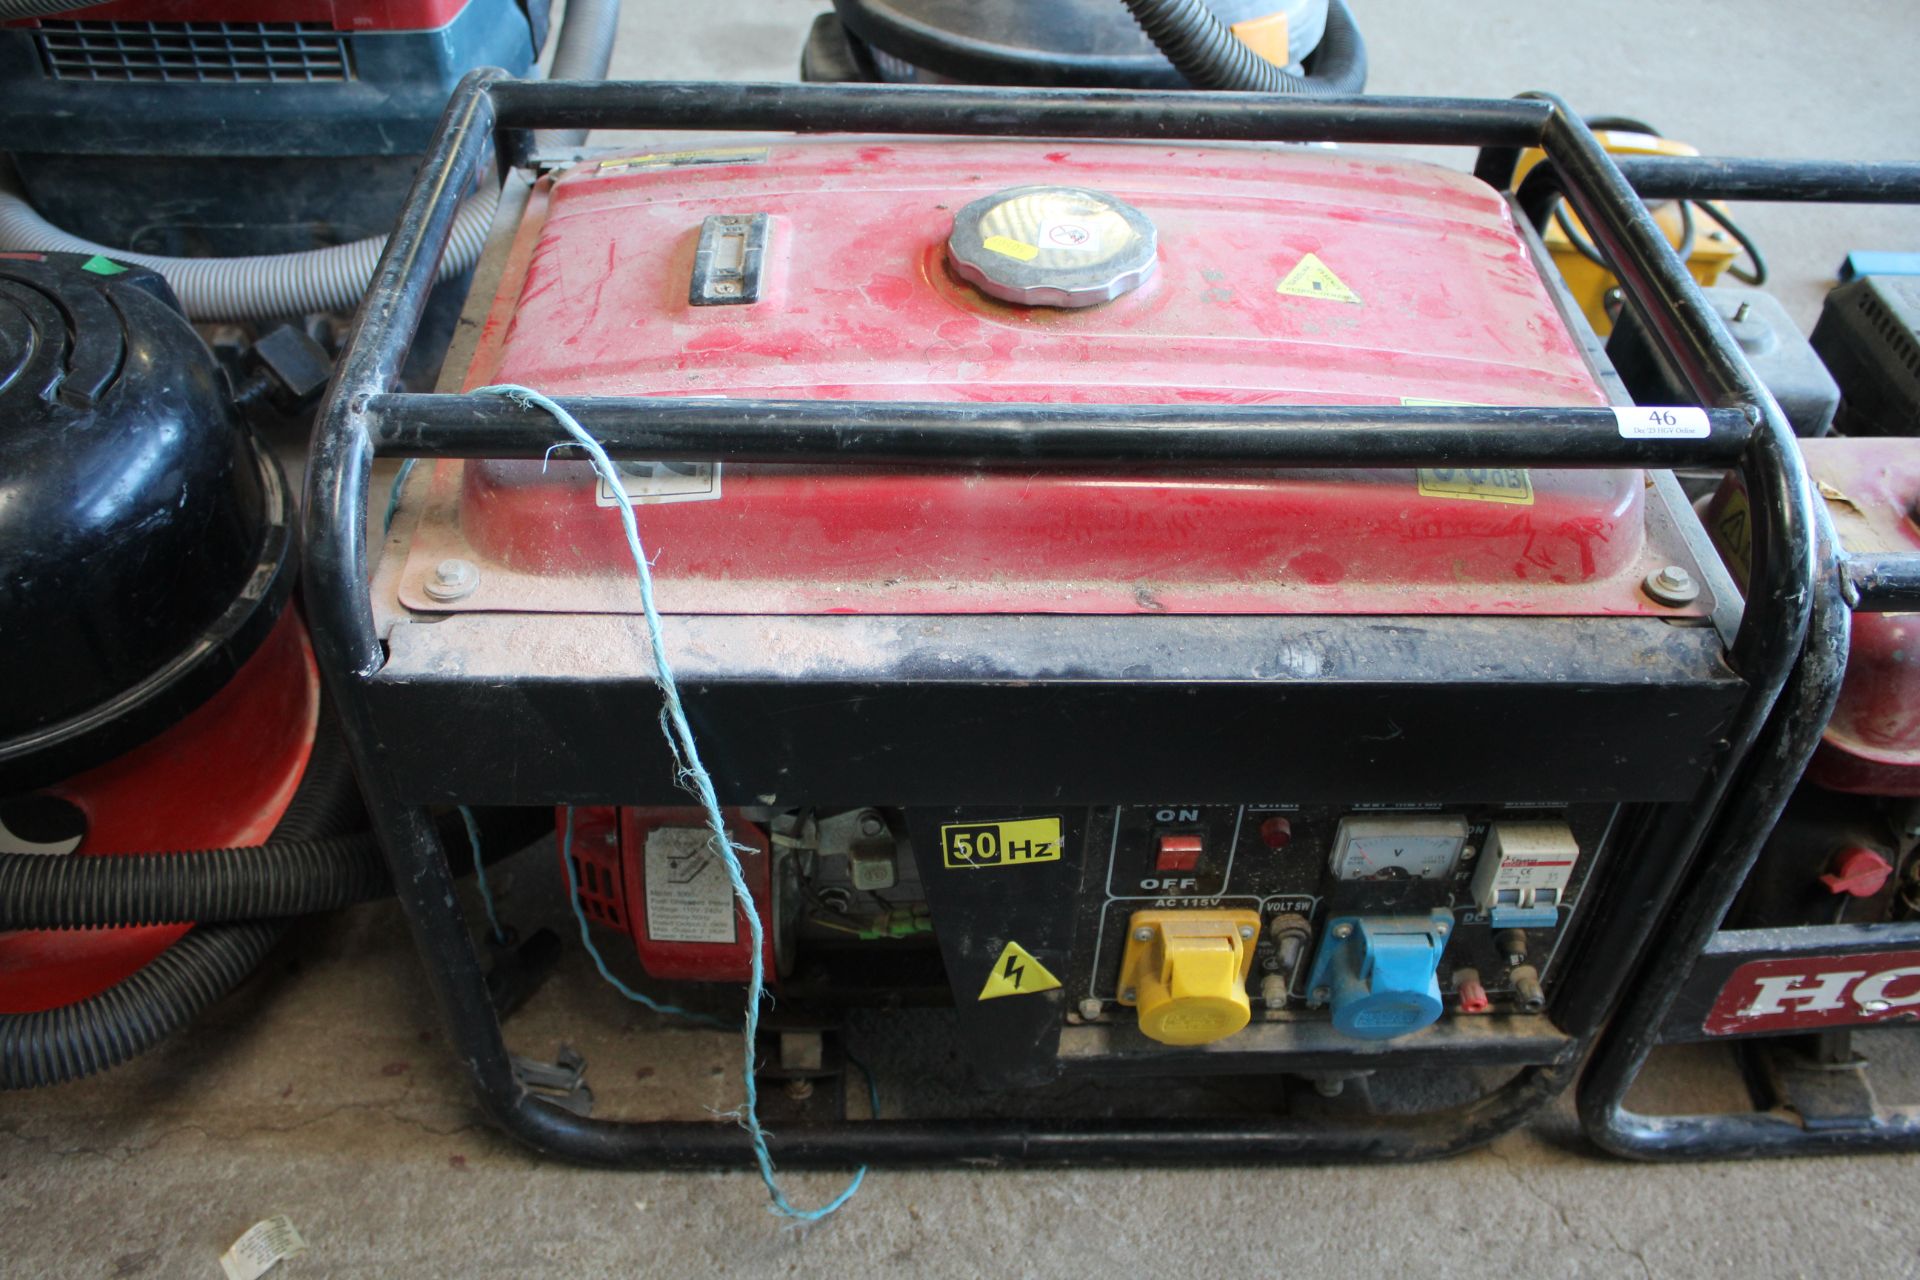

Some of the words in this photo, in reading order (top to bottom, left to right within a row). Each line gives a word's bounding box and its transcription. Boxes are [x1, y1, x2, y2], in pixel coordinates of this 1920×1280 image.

[1648, 410, 1677, 426] 46
[1155, 809, 1199, 822] ON
[953, 832, 996, 860] 50
[1008, 839, 1054, 861] Hz
[1393, 848, 1404, 857] V
[1139, 878, 1197, 890] OFF
[1154, 899, 1177, 907] AC
[1181, 898, 1221, 907] 115V
[1266, 902, 1294, 912] VOLT
[1294, 902, 1311, 911] SW
[1463, 912, 1485, 921] DC
